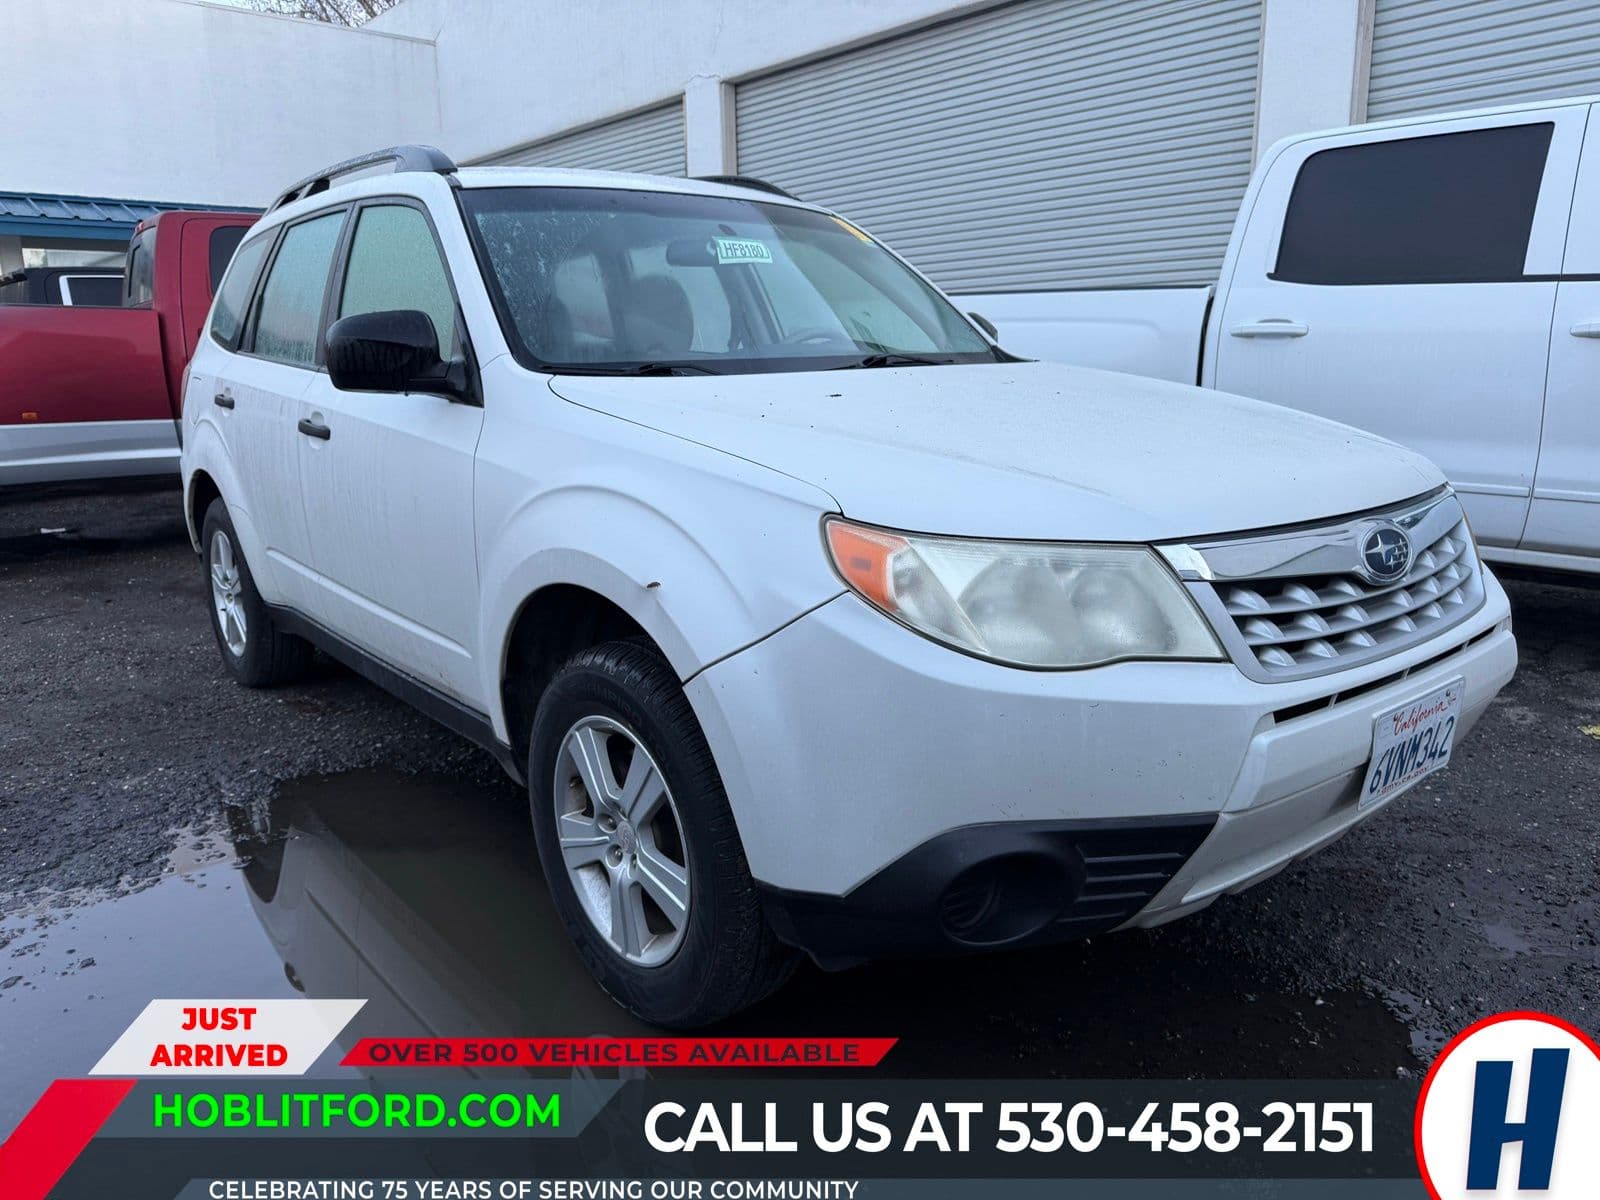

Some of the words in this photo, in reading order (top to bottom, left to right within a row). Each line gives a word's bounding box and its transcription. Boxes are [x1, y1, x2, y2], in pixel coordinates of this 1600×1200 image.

[723, 242, 765, 258] HF8180
[1393, 701, 1449, 736] California
[1369, 715, 1455, 794] 6VNM342
